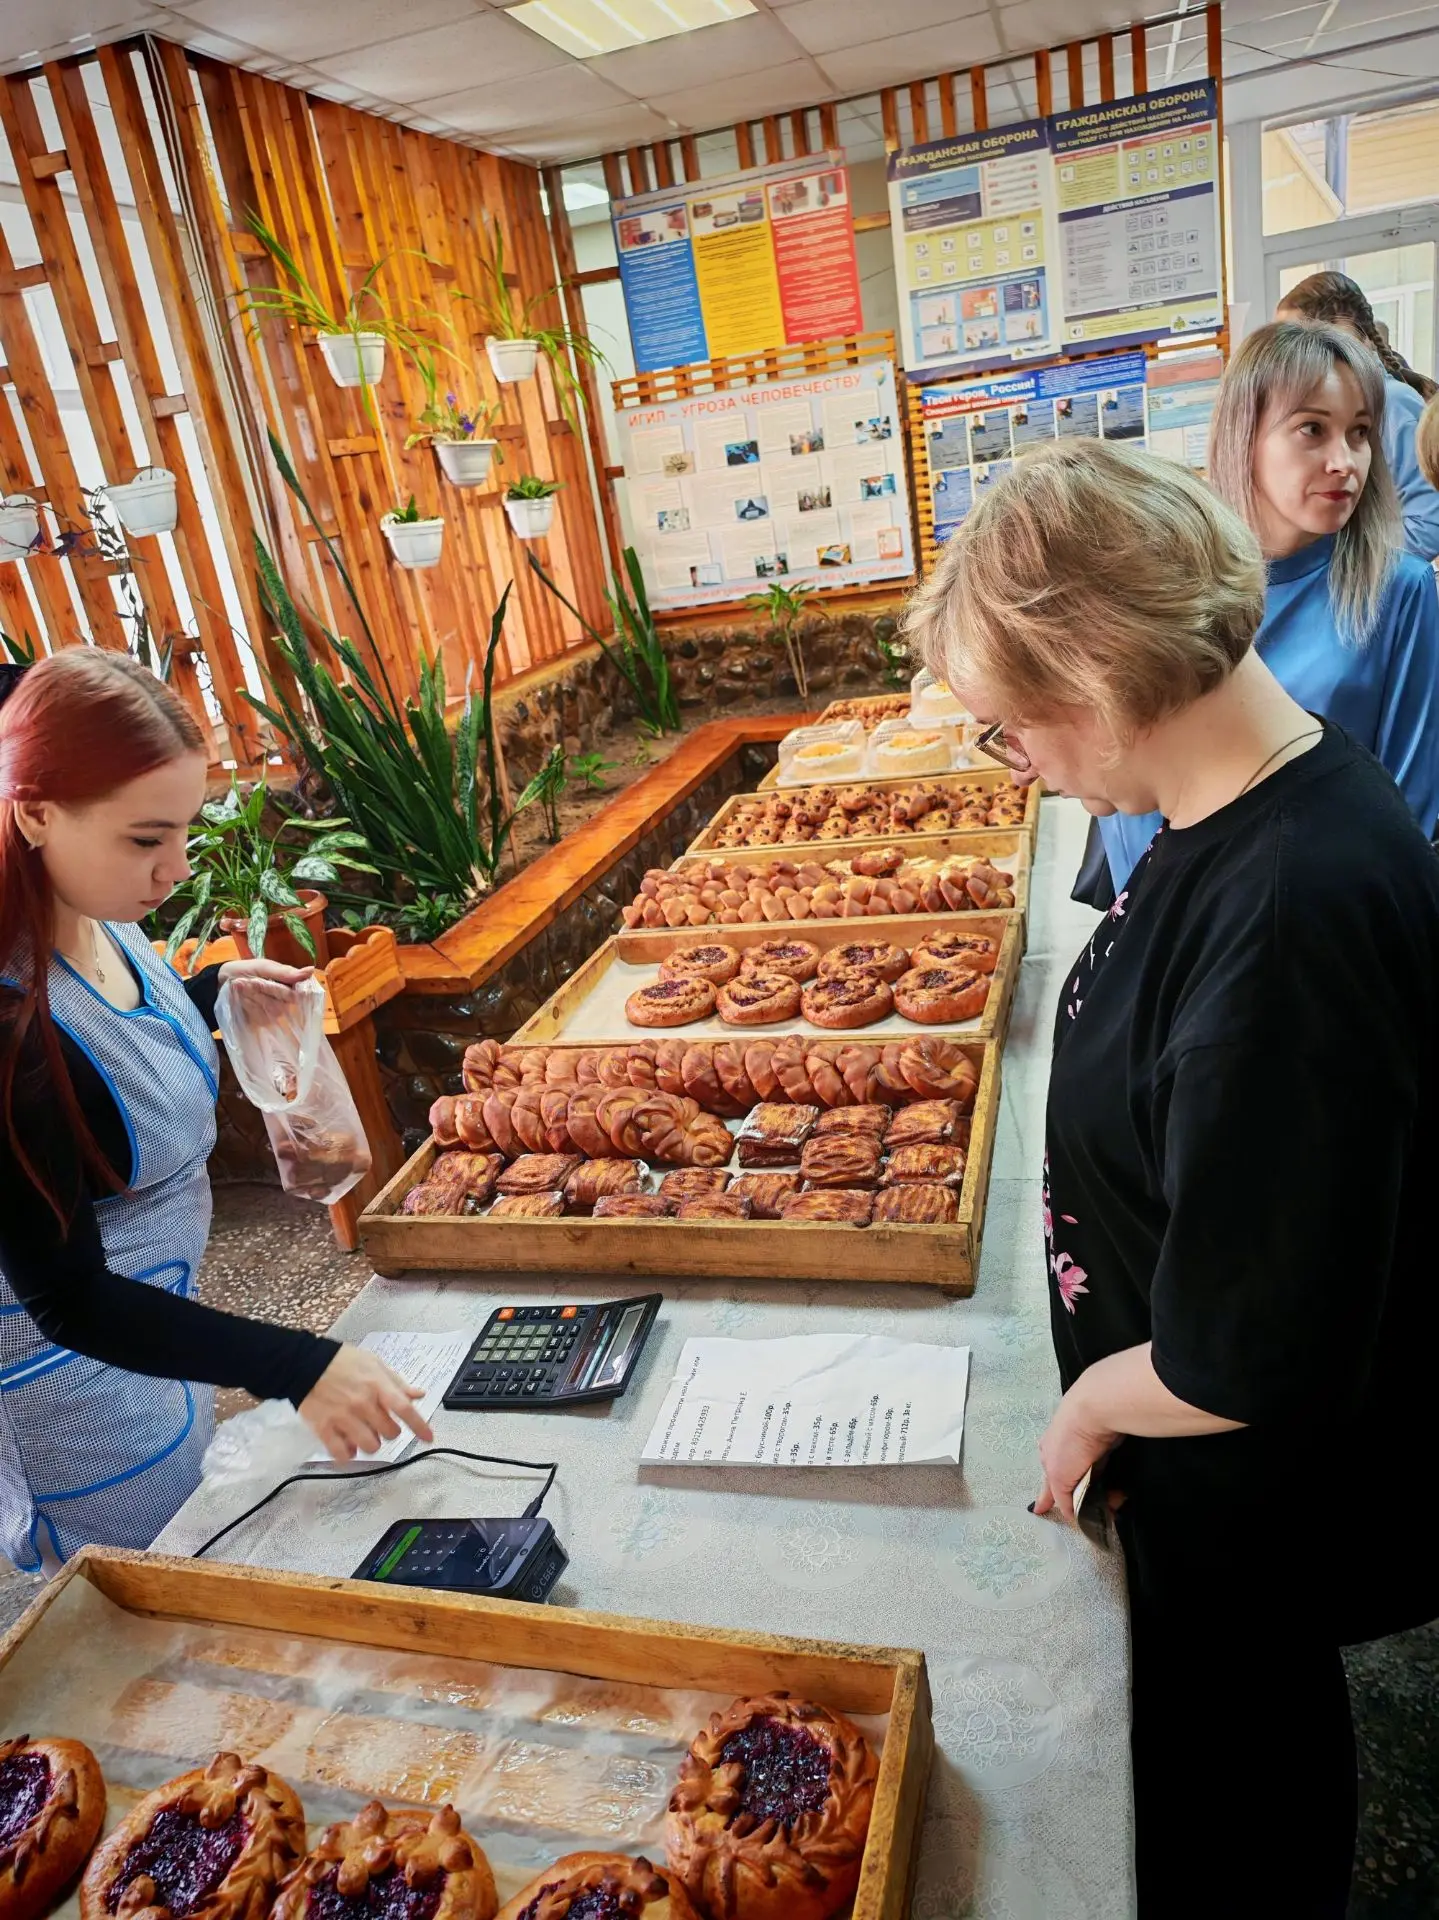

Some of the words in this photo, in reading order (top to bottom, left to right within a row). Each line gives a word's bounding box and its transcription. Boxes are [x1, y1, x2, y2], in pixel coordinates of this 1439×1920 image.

[1056, 103, 1146, 131] ГРАЖДАНСКАЯ
[1149, 88, 1207, 110] ОБОРОНА
[895, 142, 980, 168] ГРАЖДАНСКАЯ
[982, 128, 1039, 148] ОБОРОНА
[681, 398, 737, 418] УГРОЗА
[741, 373, 862, 406] ЧЕЛОВЕЧЕСТВУ
[990, 378, 1036, 395] Россия!
[660, 1431, 671, 1454] можно
[539, 1563, 557, 1586] СБЕР
